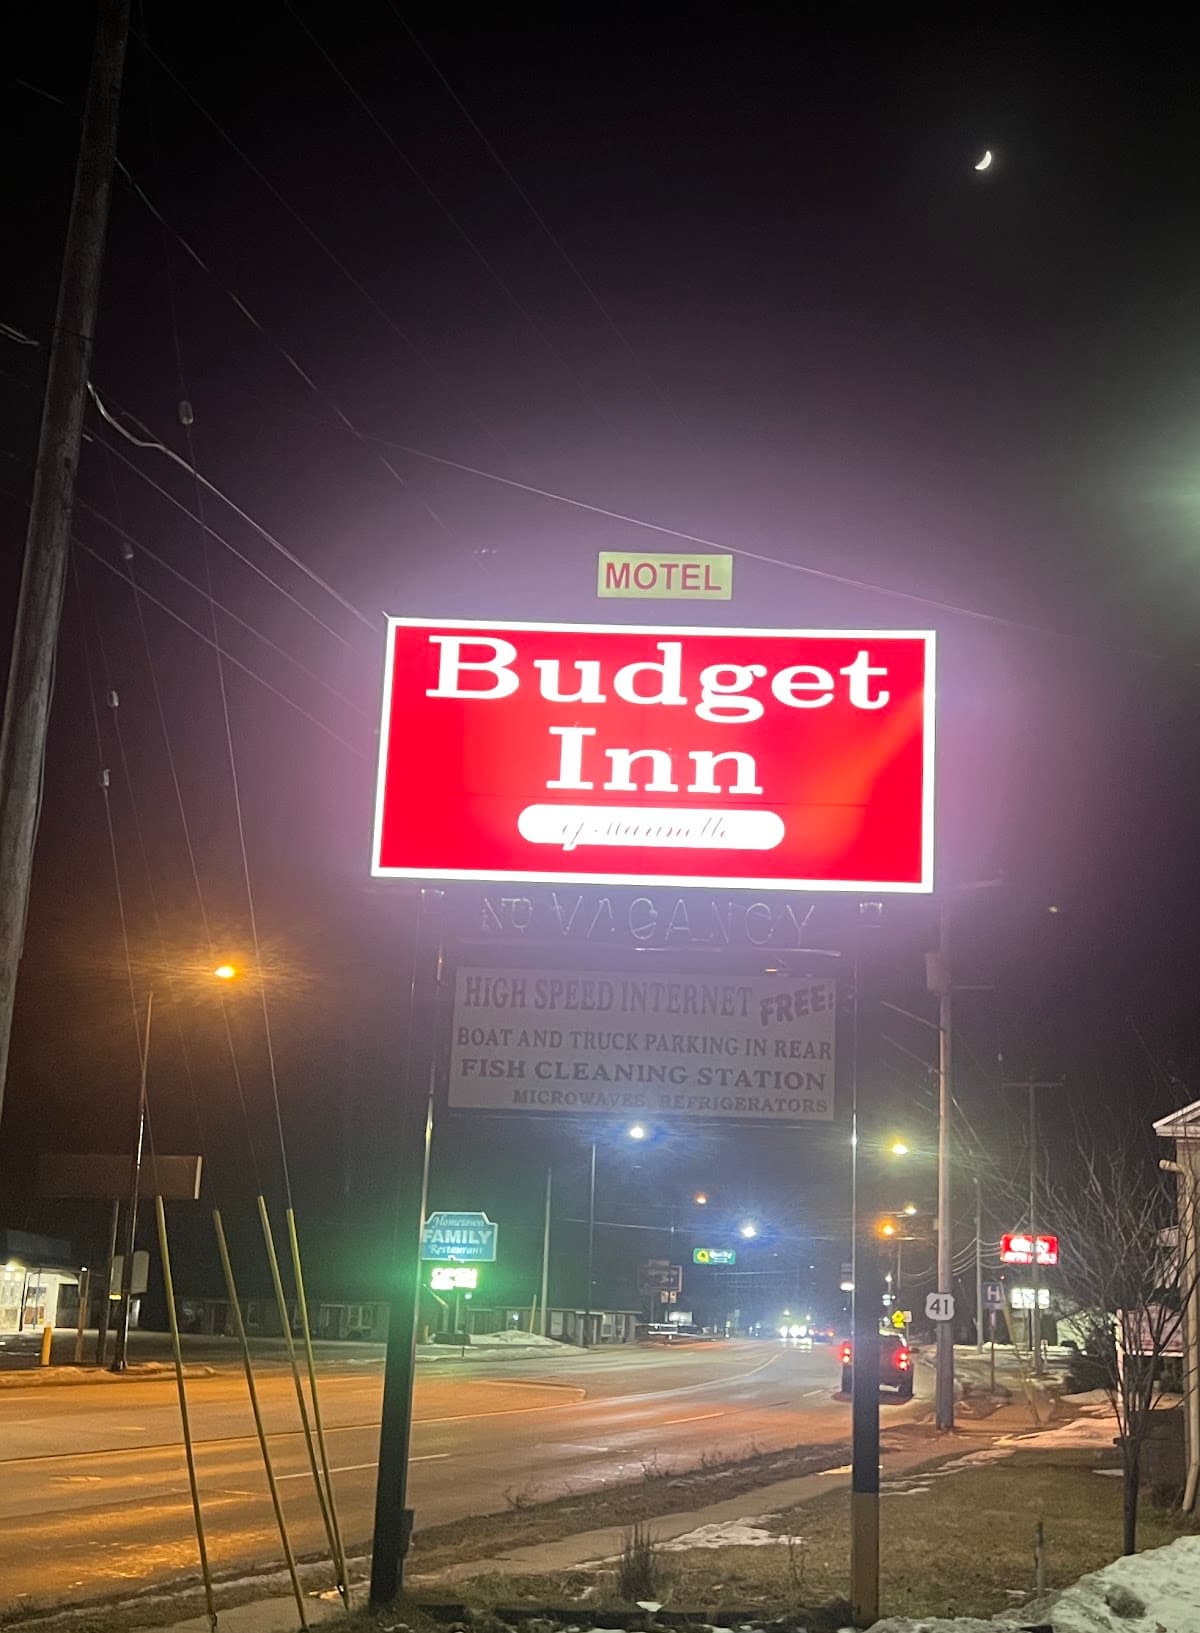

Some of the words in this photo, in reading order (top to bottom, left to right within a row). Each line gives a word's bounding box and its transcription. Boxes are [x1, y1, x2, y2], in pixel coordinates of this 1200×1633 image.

[605, 562, 722, 592] MOTEL
[425, 634, 890, 724] Budget
[546, 726, 764, 795] Inn
[551, 891, 817, 946] VACANCY
[464, 975, 527, 1008] HIGH
[534, 979, 614, 1012] SPEED
[621, 981, 754, 1018] INTERNET
[457, 1028, 513, 1047] BOAT
[517, 1029, 563, 1049] AND
[570, 1031, 640, 1052] TRUCK
[645, 1034, 739, 1057] PARKING
[746, 1038, 768, 1059] IN
[775, 1039, 833, 1061] REAR
[461, 1059, 526, 1079] FISH
[535, 1060, 689, 1086] CLEANING
[697, 1067, 826, 1092] STATION
[662, 1092, 828, 1114] REFRIGERATORS
[422, 1229, 492, 1245] FAMILY
[929, 1298, 949, 1316] 41
